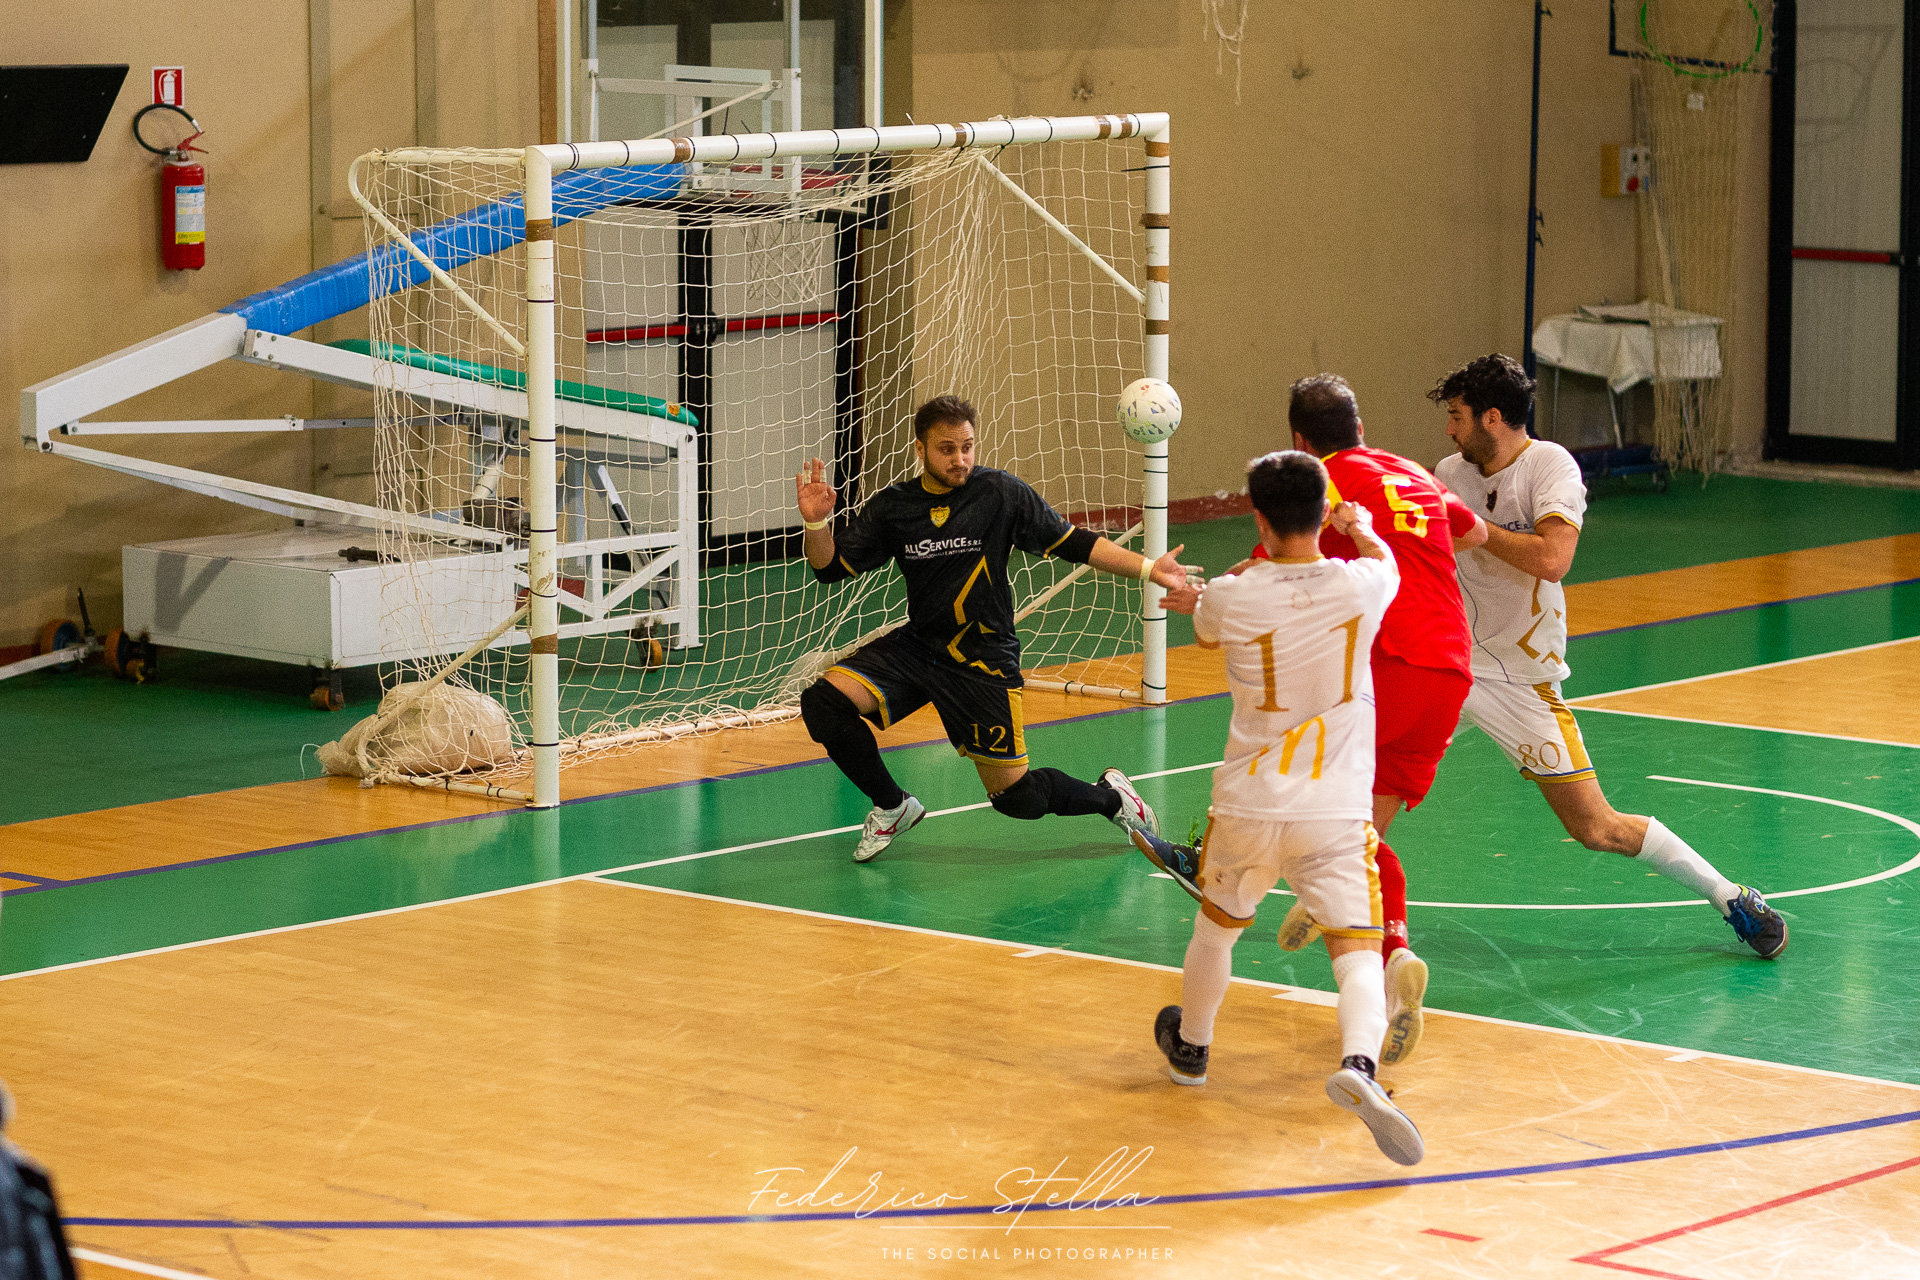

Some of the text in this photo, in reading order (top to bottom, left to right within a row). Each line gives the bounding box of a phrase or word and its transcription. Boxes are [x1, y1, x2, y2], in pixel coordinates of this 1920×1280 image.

[1381, 474, 1429, 538] 5
[1244, 613, 1364, 712] 11
[970, 723, 1009, 754] 12
[1518, 741, 1560, 769] 80
